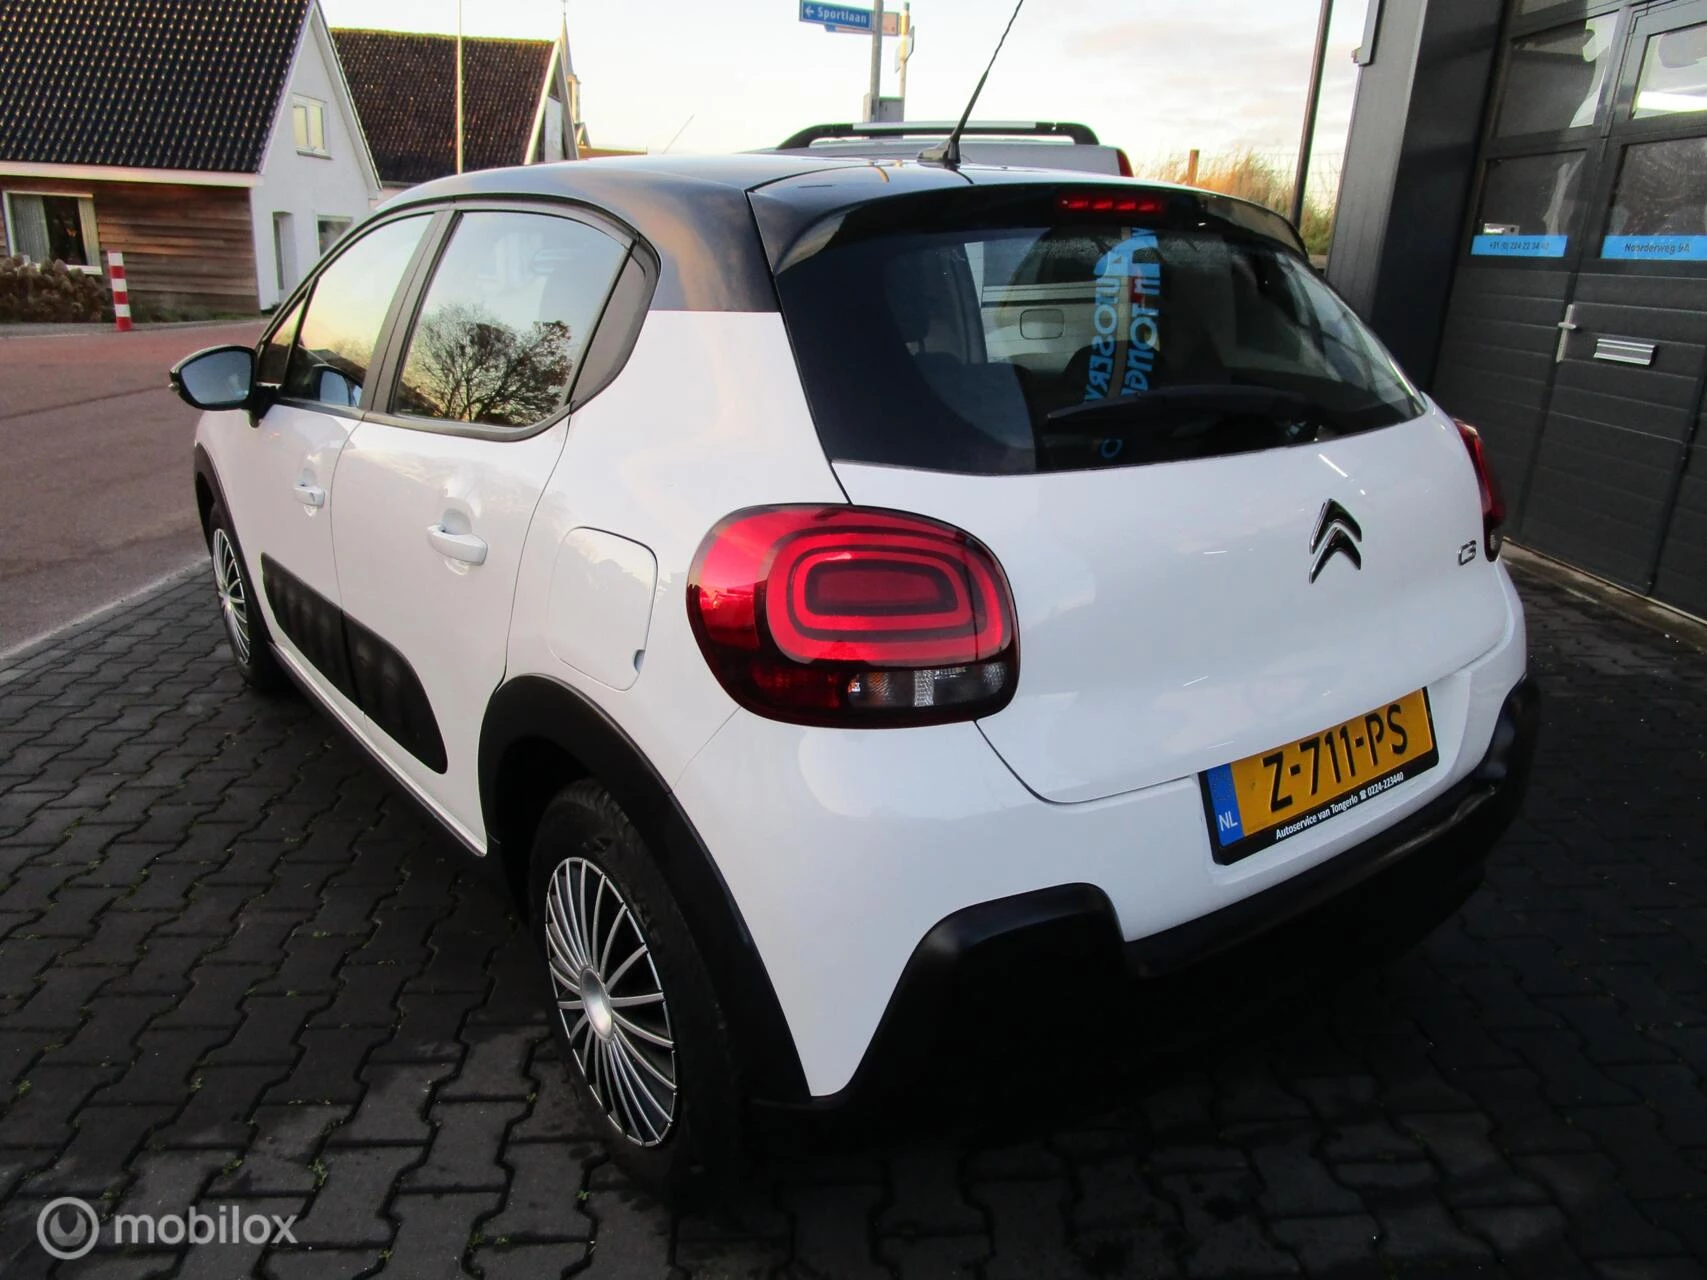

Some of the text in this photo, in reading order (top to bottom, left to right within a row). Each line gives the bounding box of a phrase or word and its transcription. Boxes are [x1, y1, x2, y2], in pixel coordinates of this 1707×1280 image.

[817, 7, 867, 23] Sportlaan
[1624, 242, 1690, 255] Noorderweg 9A
[1262, 703, 1408, 813] Z-711-PS
[1276, 771, 1404, 840] Autoservice van Tongerlo 0224-223440
[1218, 811, 1238, 832] NL
